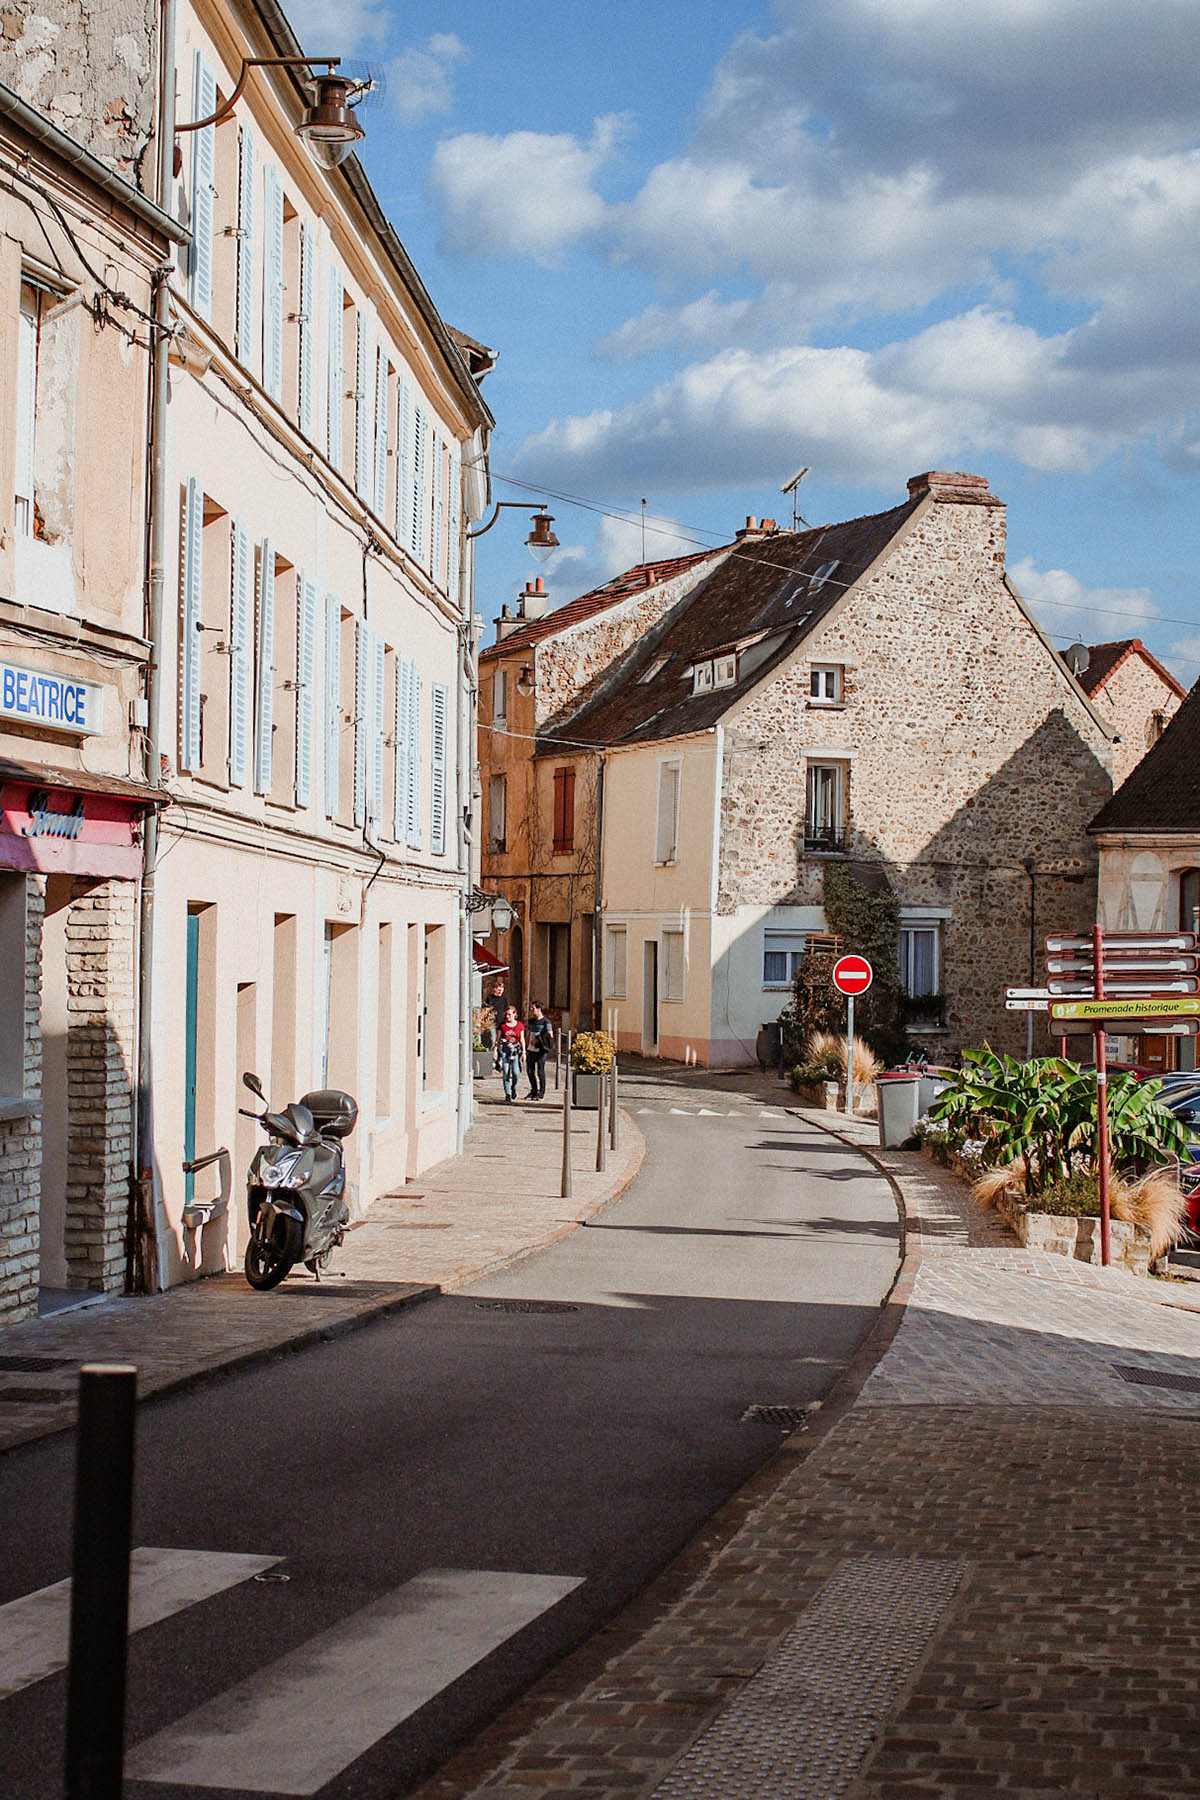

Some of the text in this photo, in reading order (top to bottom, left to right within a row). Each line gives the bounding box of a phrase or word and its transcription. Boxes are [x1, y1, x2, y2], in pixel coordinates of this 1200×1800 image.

[4, 669, 86, 725] BEATRICE
[1083, 1003, 1180, 1014] Promenade historique
